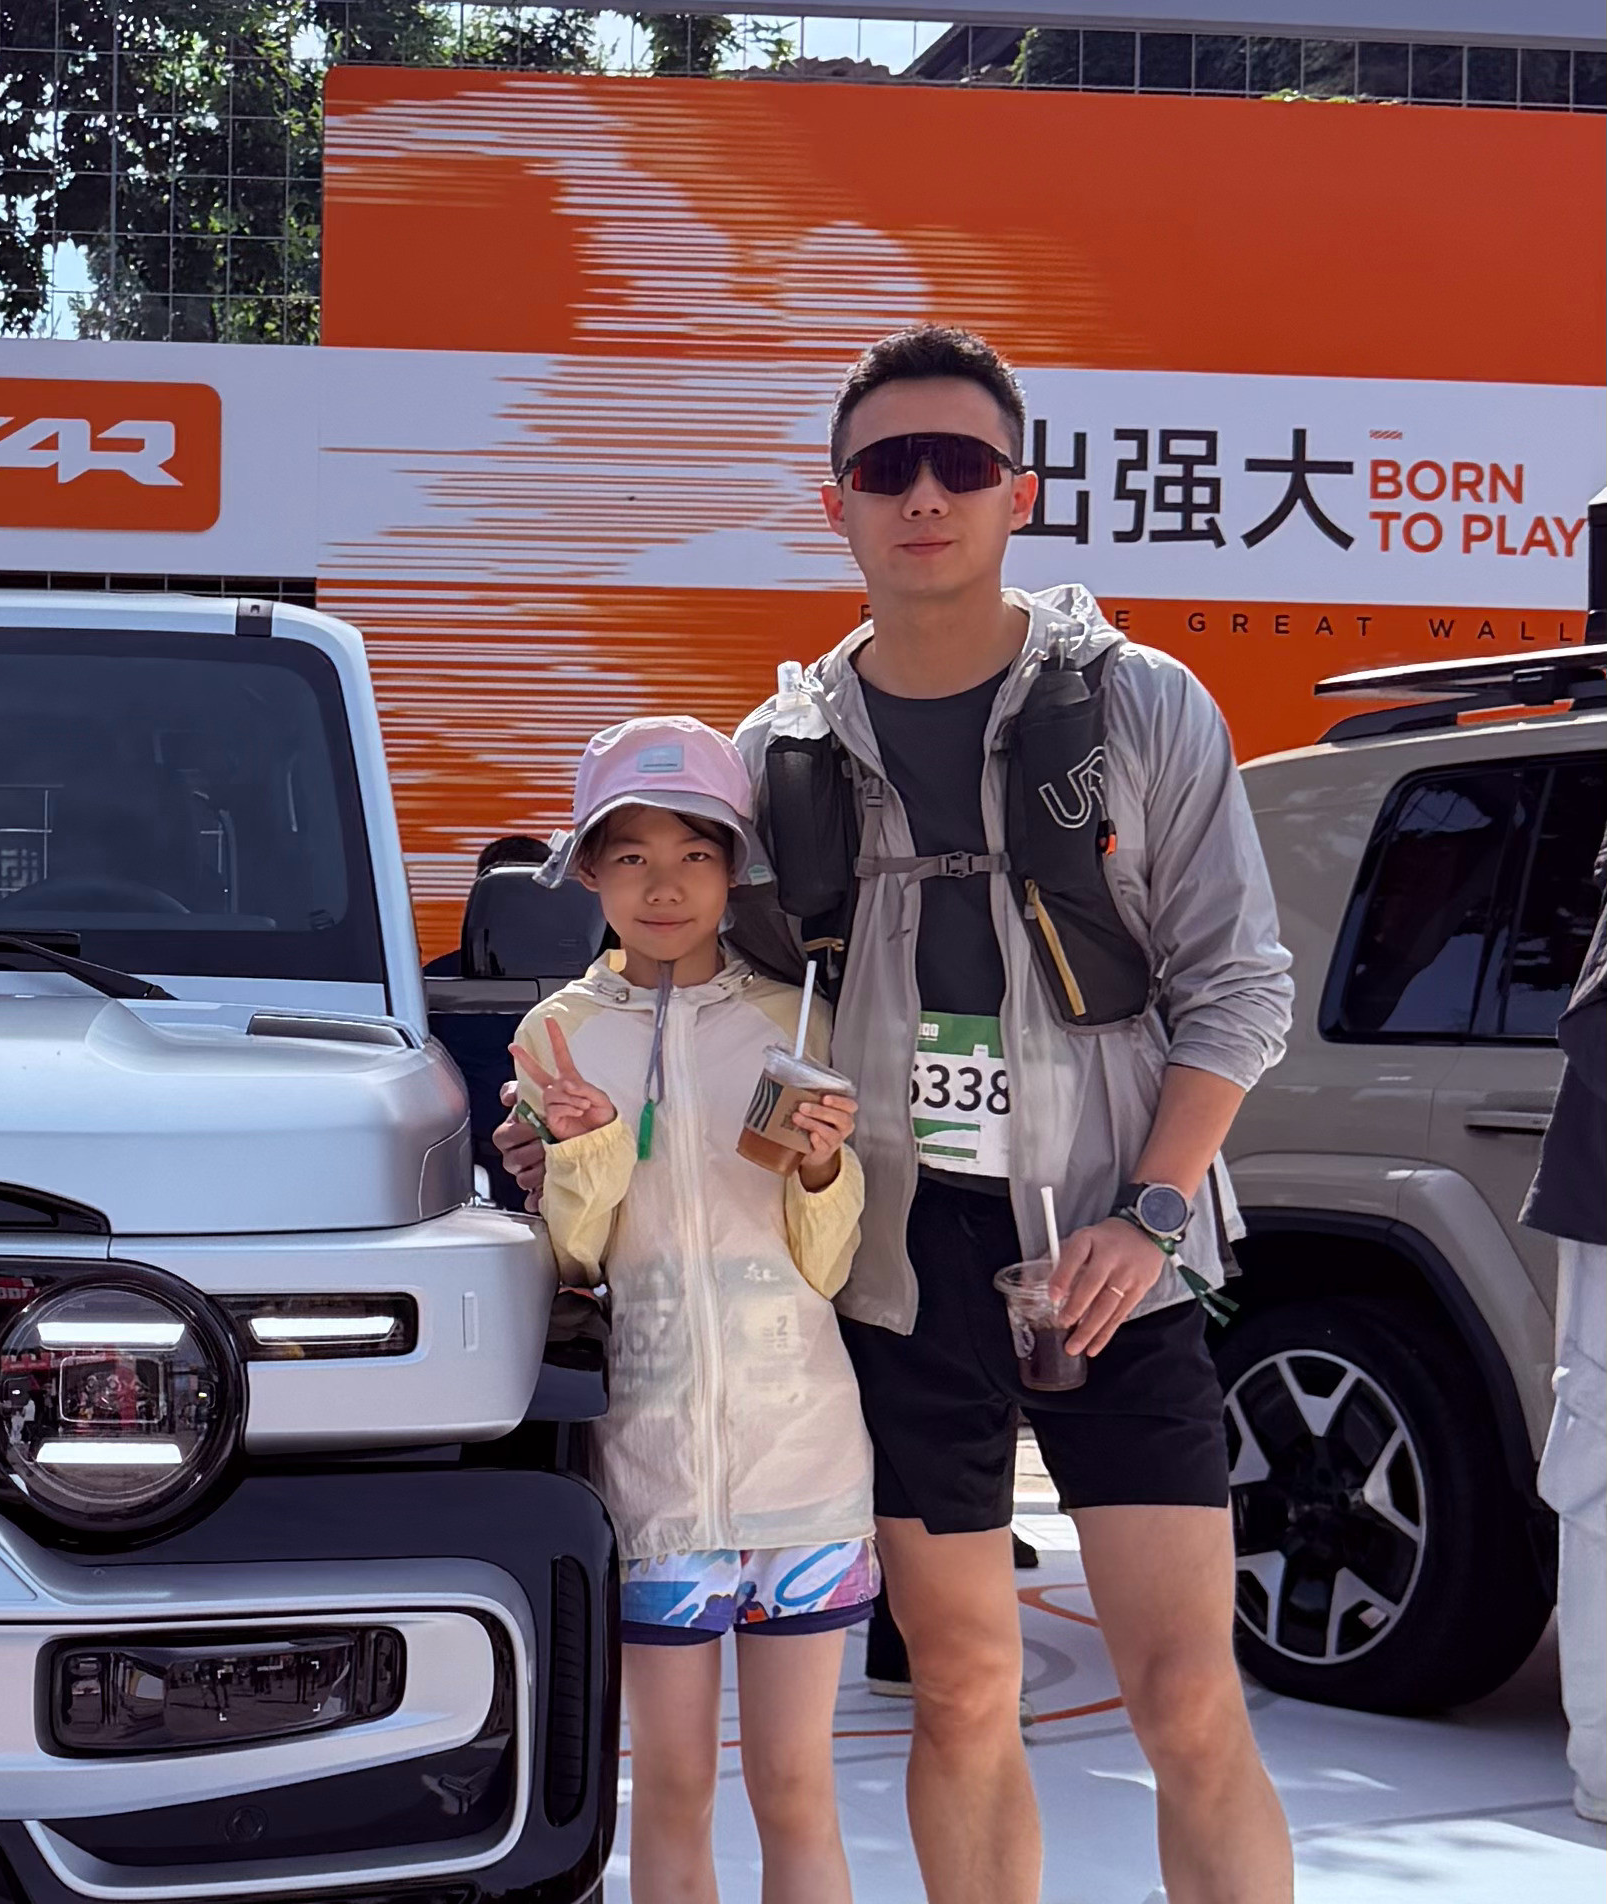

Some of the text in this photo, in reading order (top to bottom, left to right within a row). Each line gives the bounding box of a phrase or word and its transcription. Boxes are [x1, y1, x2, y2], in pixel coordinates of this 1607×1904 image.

[1010, 418, 1355, 552] 出强大
[1369, 458, 1524, 505] BORN
[1369, 510, 1587, 558] TO PLAY
[1188, 611, 1574, 643] GREAT WALL
